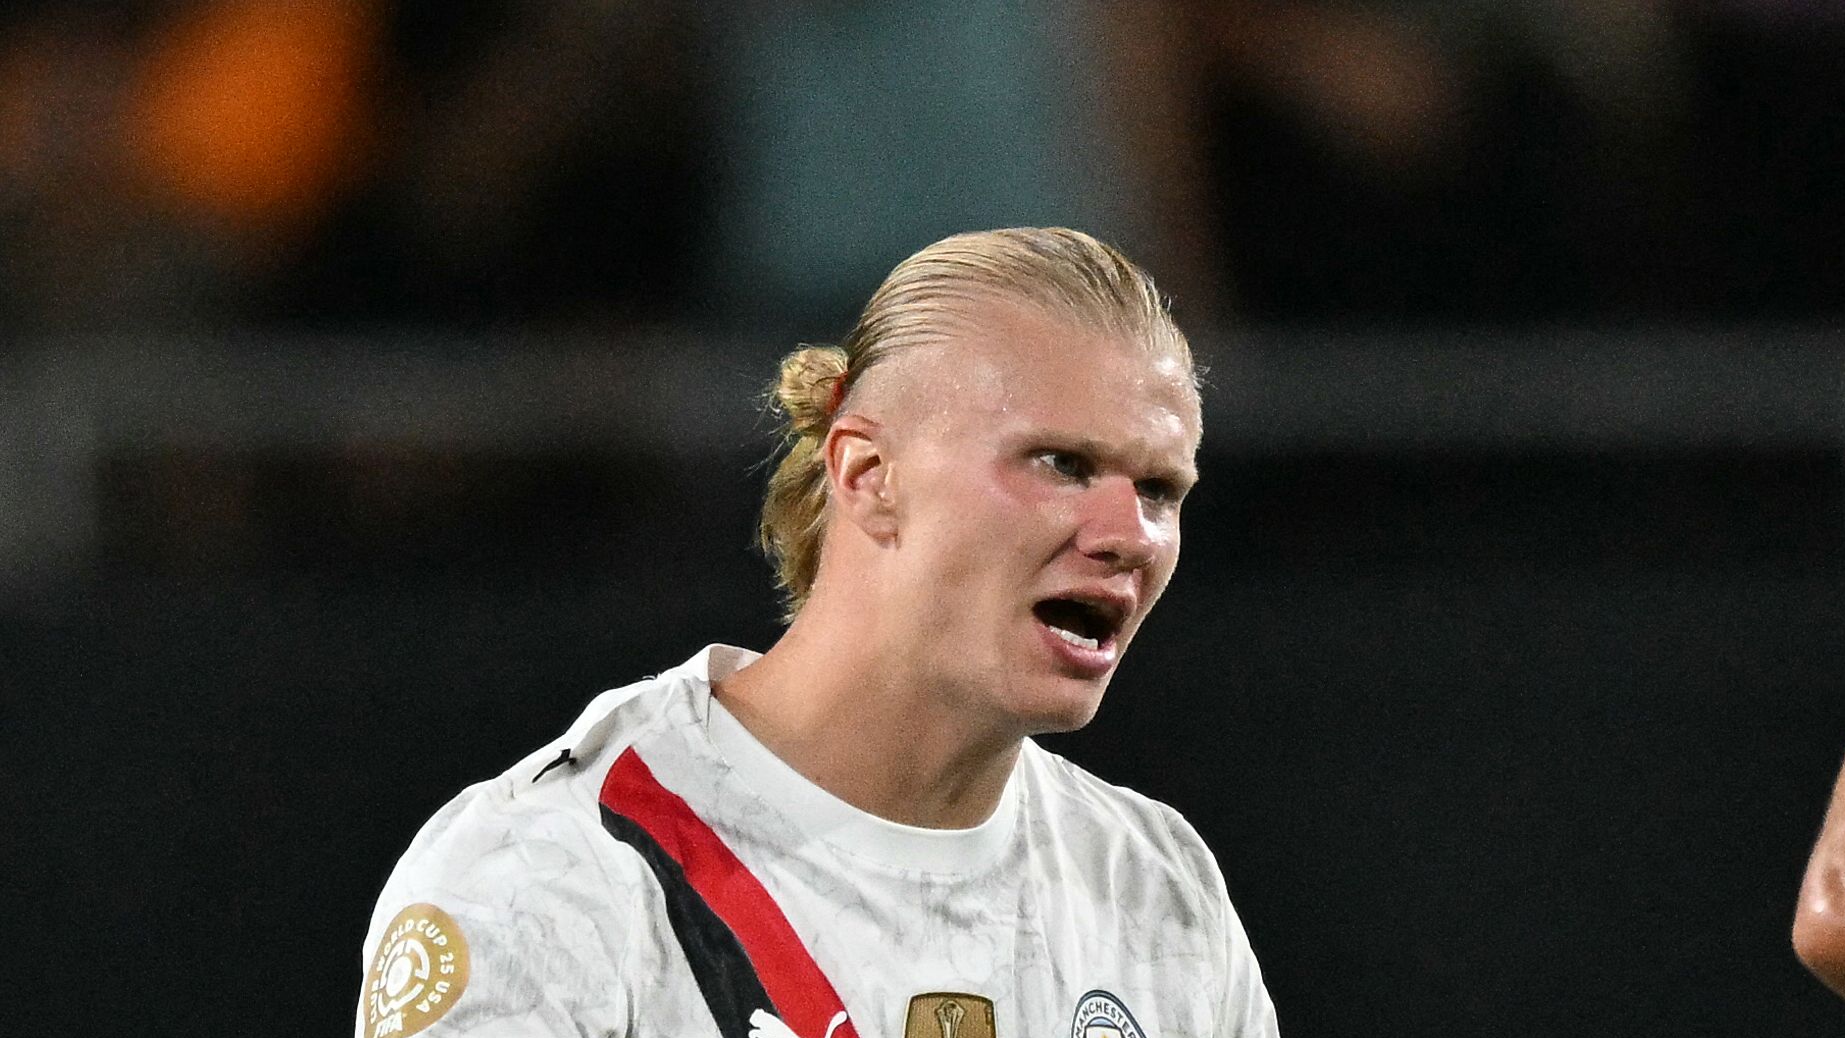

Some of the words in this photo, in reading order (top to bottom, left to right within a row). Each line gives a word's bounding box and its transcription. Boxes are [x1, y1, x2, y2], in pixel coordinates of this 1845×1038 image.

[376, 919, 415, 972] WORLD
[416, 919, 449, 947] CUP
[440, 952, 455, 976] 25
[416, 981, 451, 1014] USA
